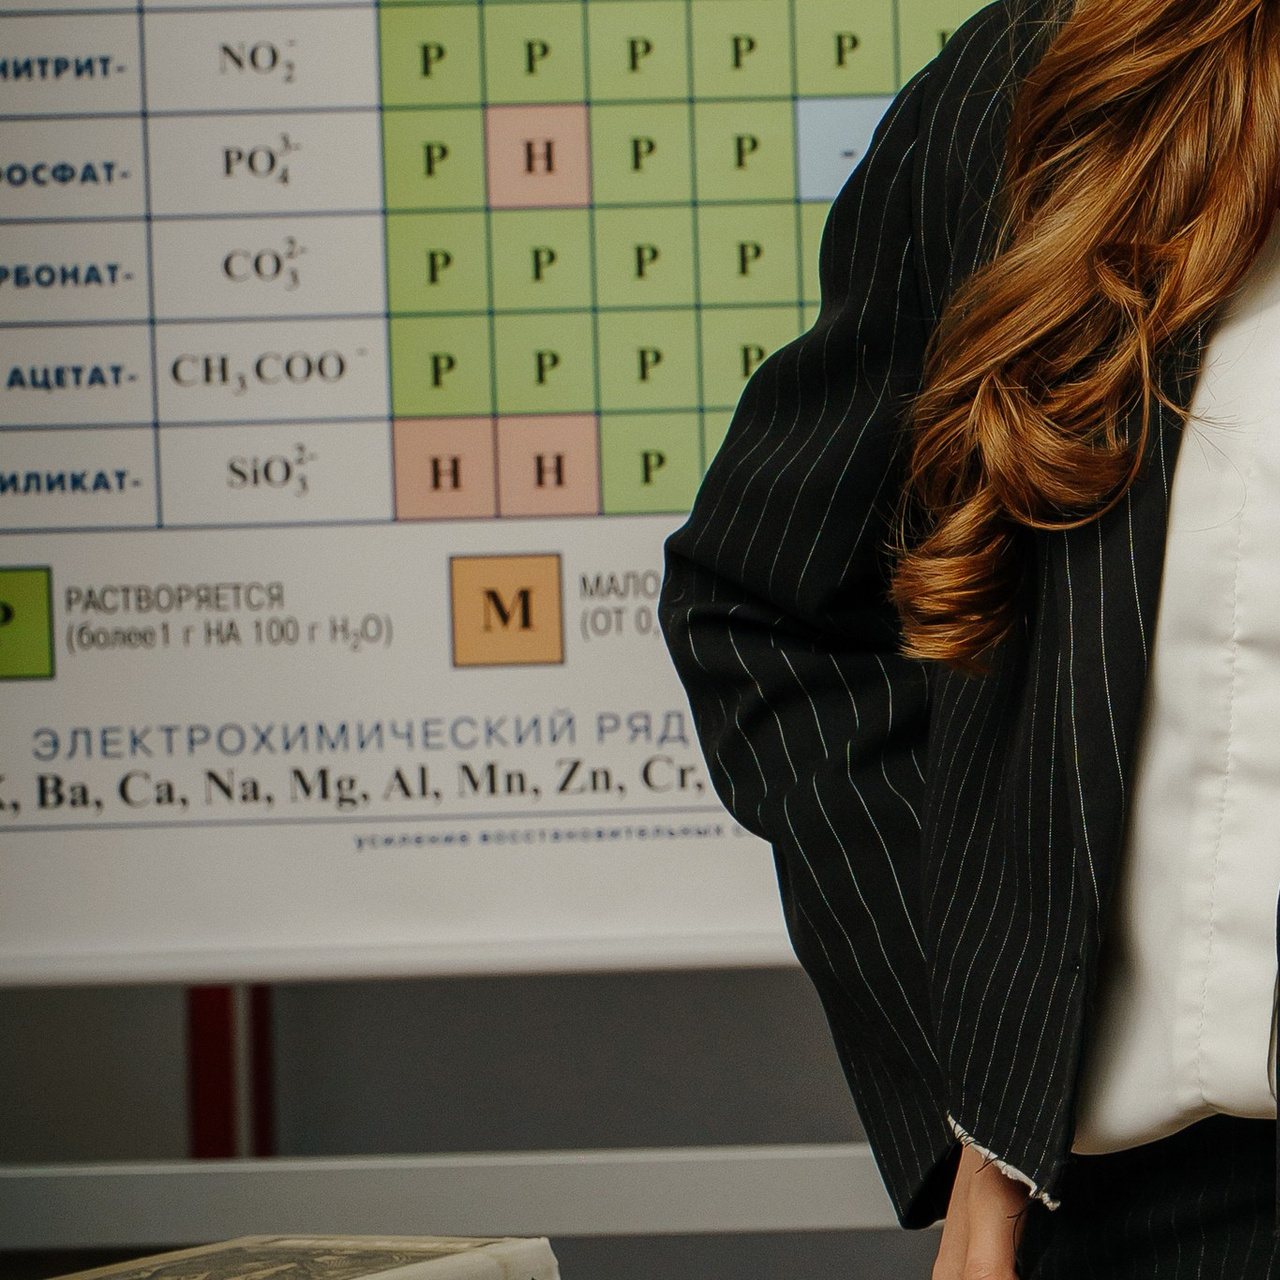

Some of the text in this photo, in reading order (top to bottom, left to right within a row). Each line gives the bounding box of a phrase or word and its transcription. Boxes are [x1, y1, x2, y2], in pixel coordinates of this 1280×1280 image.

[0, 161, 132, 190] ОСФАТ-
[7, 363, 138, 391] АЦЕТАТ-
[64, 581, 285, 616] РАСТВОРЯЕТСЯ
[203, 619, 243, 648] НА
[253, 615, 300, 648] 100
[579, 606, 624, 643] (ОТ
[31, 706, 690, 762] ЭЛЕКТРОХИМИЧЕСКИЙ РЯД
[37, 772, 104, 815] Ba,
[118, 770, 188, 811] Ca,
[203, 768, 274, 808] Na,
[290, 765, 370, 808] Mg,
[382, 762, 442, 803] Al,
[457, 760, 540, 801] Mn,
[555, 757, 625, 797] Zn,
[641, 755, 706, 793] Cr,
